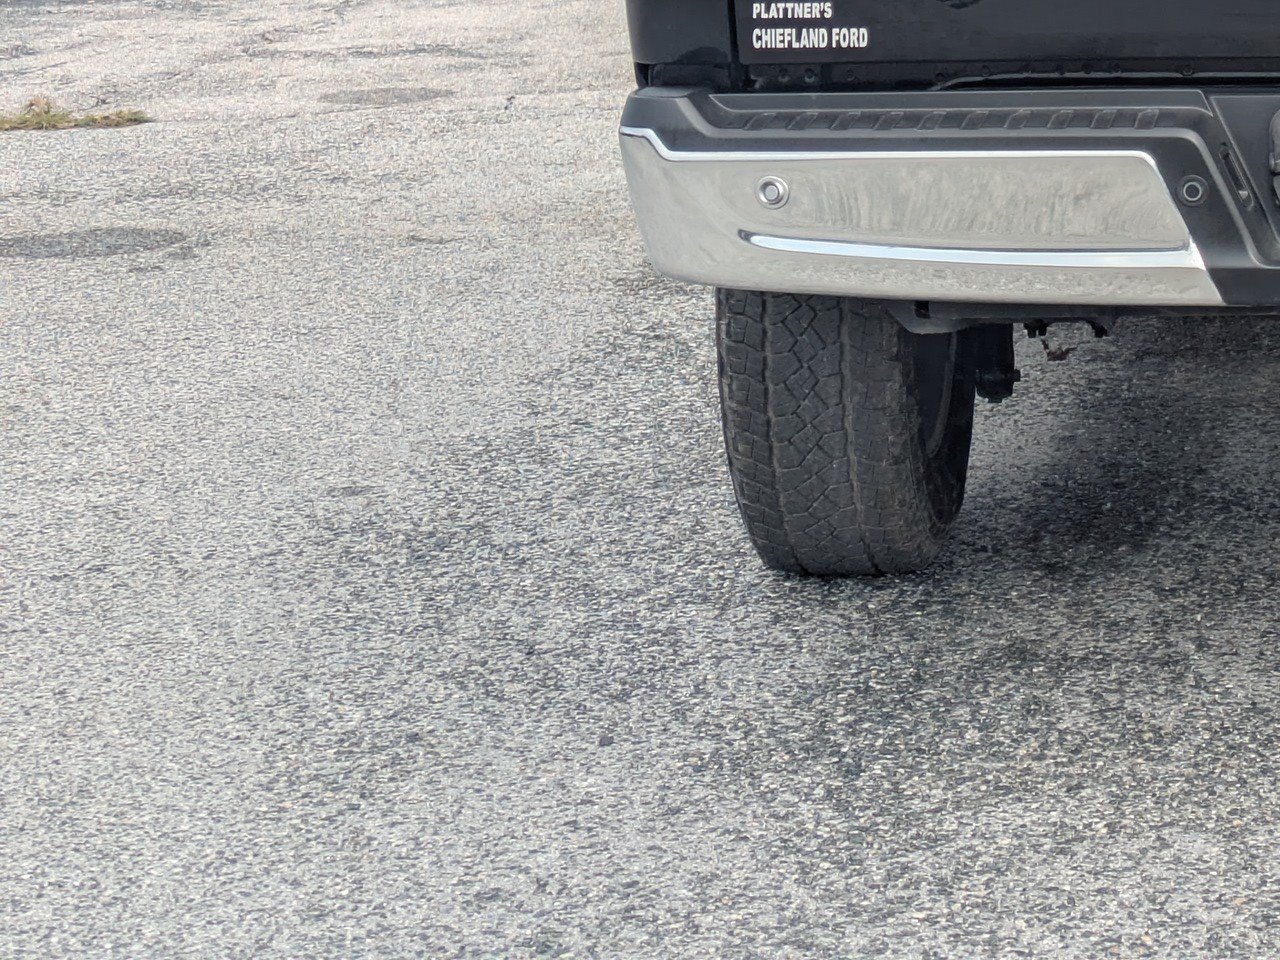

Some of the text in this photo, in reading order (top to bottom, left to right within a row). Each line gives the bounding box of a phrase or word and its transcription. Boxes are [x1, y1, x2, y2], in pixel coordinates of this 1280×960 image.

[752, 2, 833, 19] PLATTNER'S
[752, 27, 868, 49] CHIEFLAND FORD
